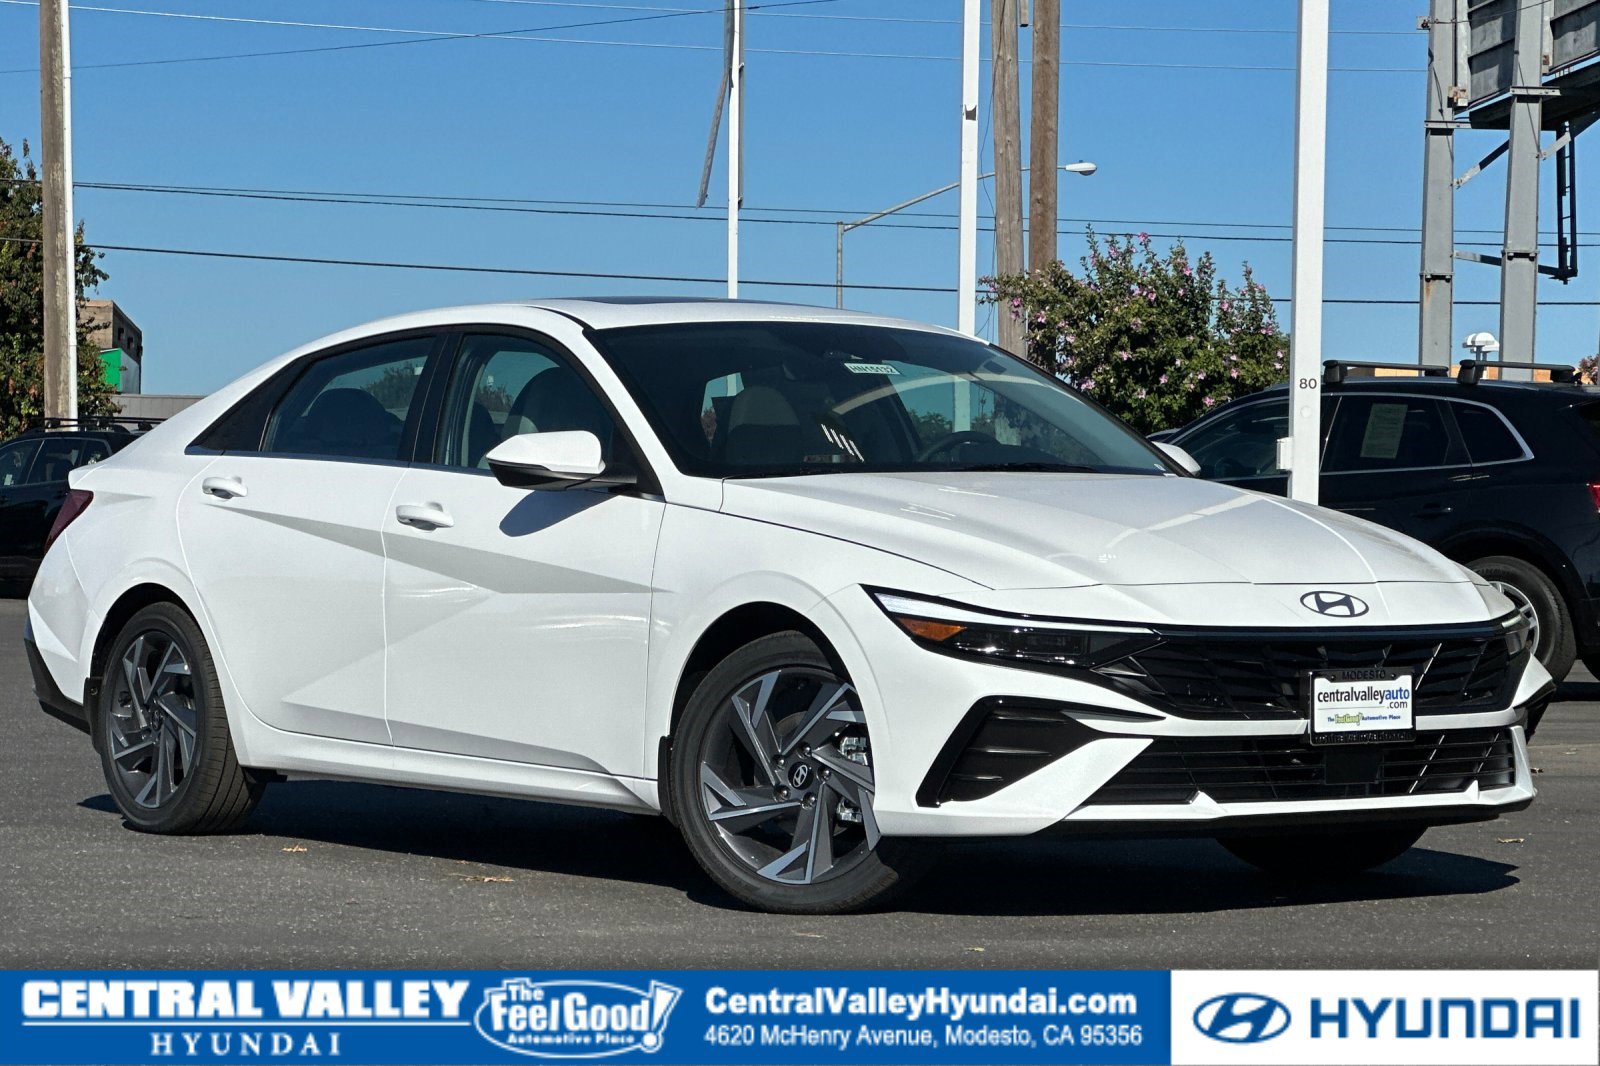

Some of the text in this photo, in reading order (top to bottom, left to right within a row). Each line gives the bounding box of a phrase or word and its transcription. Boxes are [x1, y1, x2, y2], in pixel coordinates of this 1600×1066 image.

[1299, 378, 1317, 389] 80
[1342, 670, 1386, 680] MODESTO
[1317, 686, 1410, 704] centralvalleyauto
[1387, 701, 1408, 709] .com
